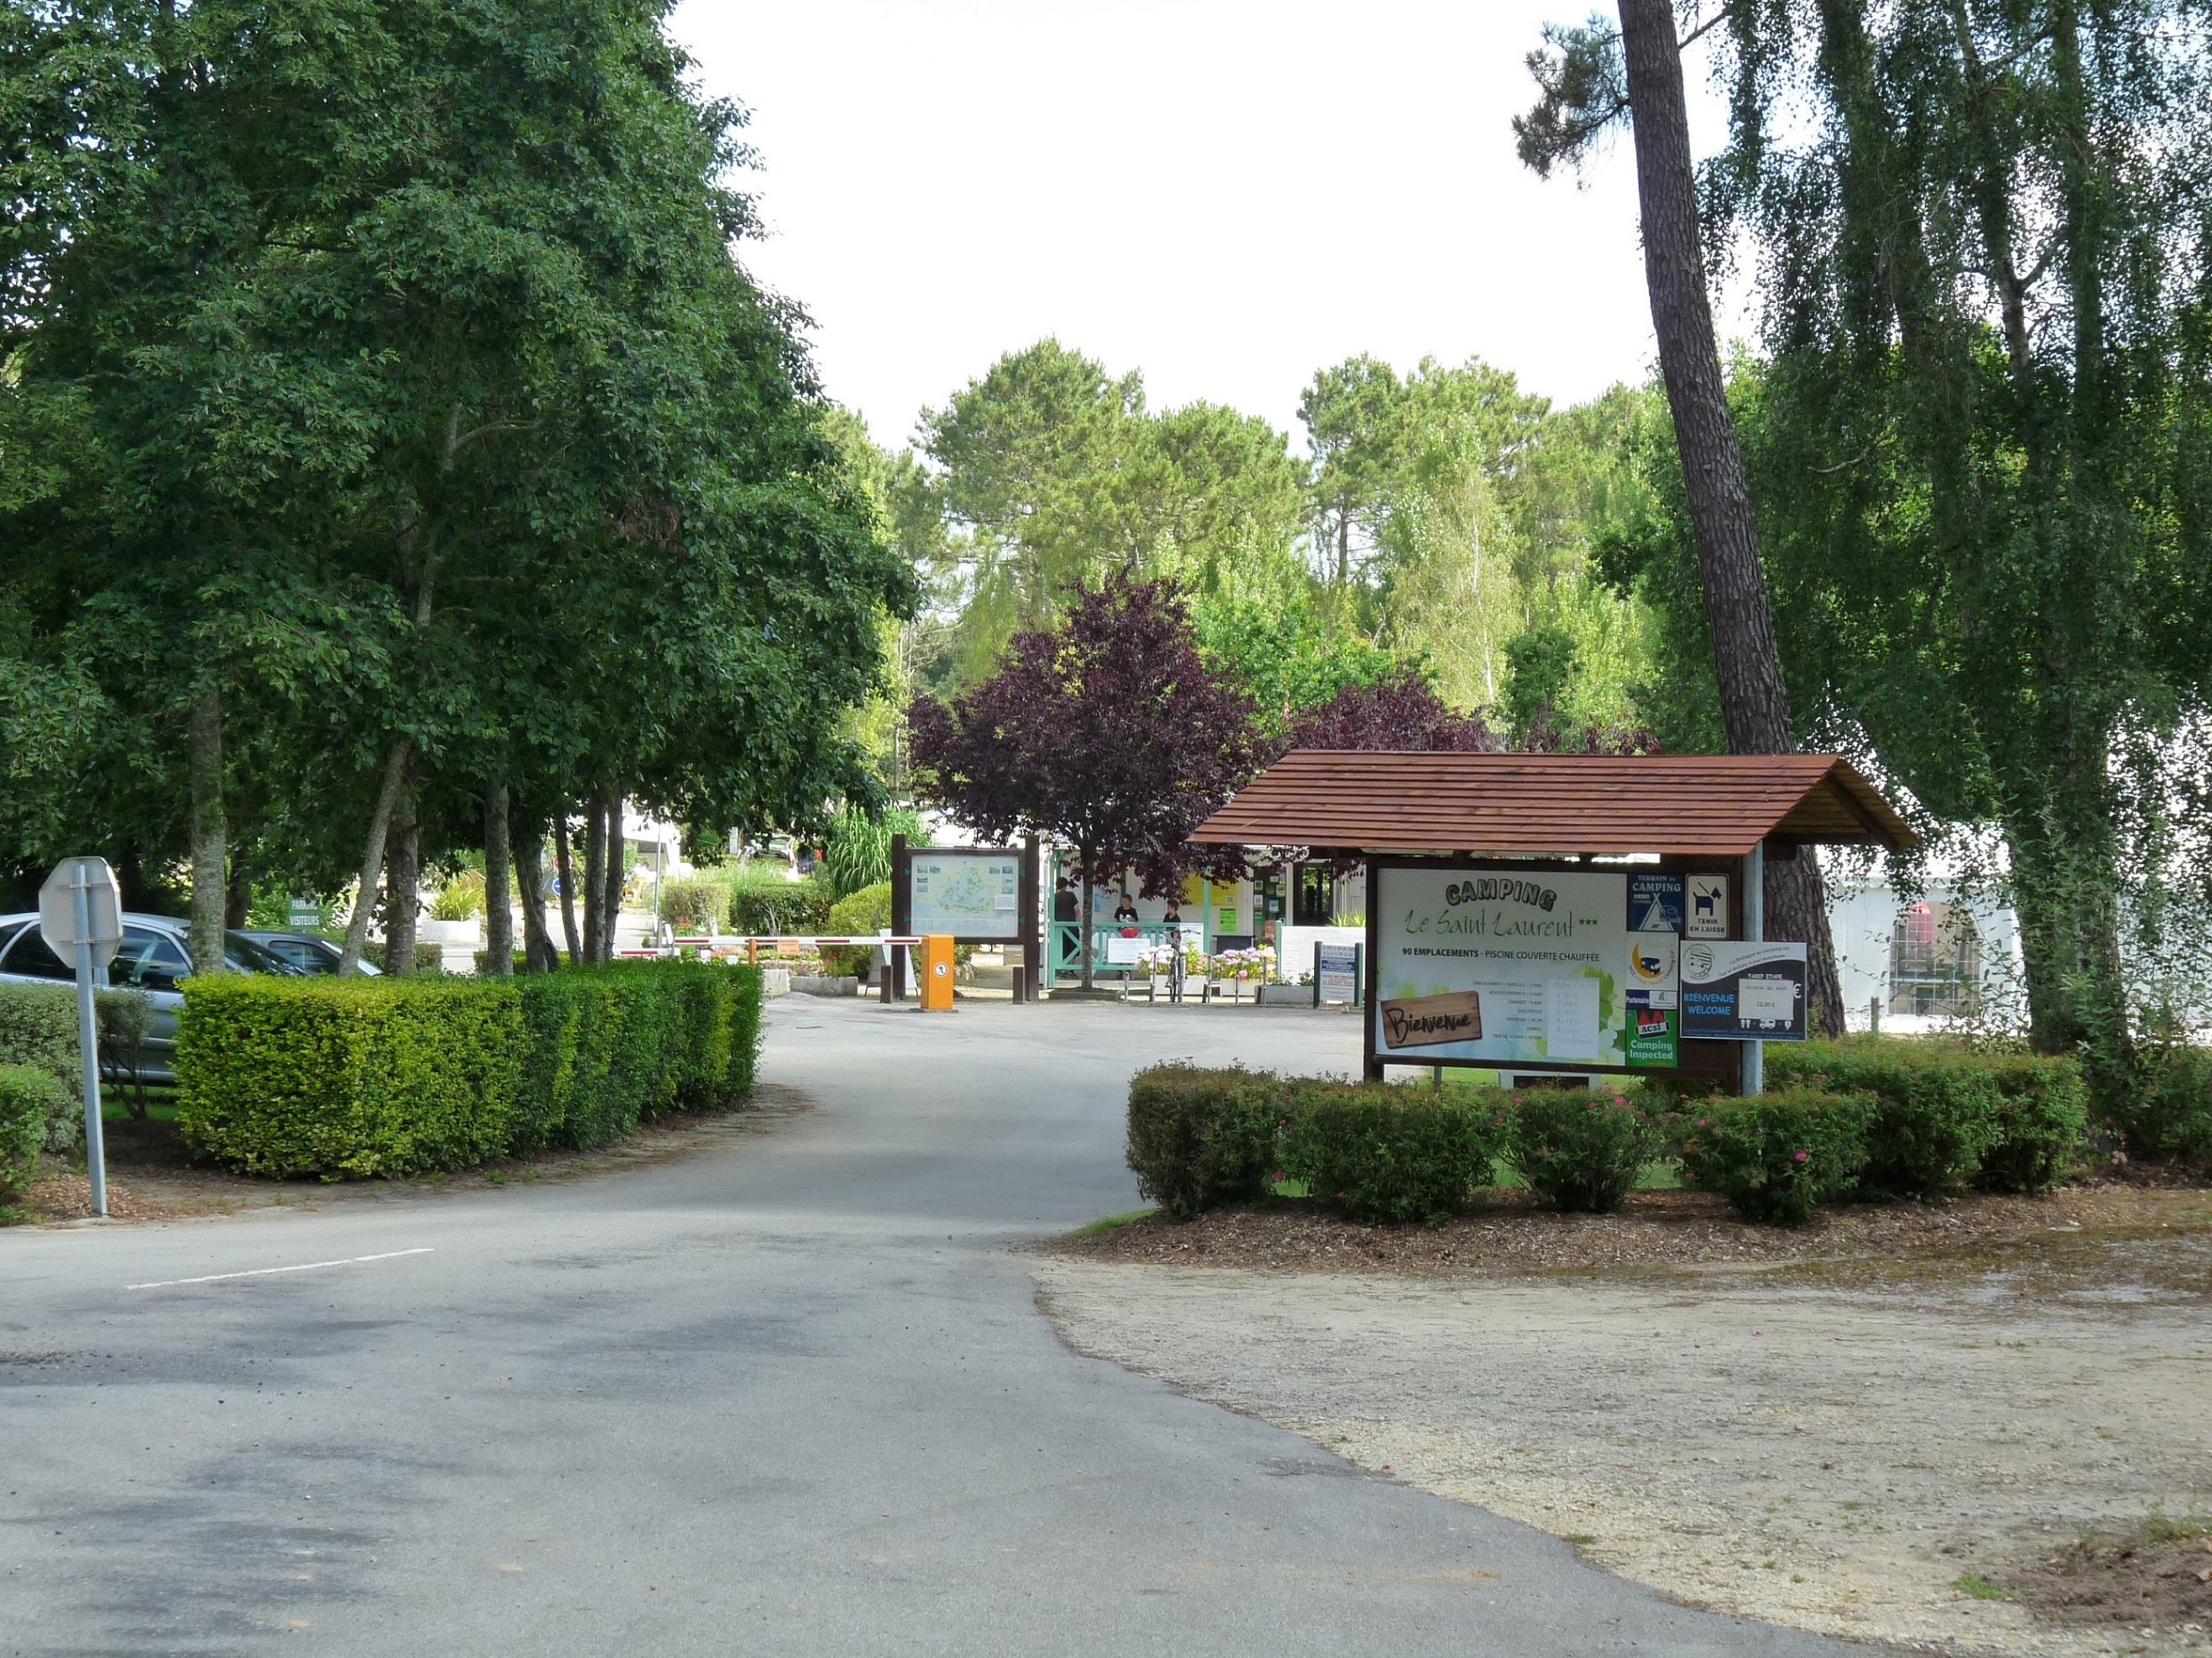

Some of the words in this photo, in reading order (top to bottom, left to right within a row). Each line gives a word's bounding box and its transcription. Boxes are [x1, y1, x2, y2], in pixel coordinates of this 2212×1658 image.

[1632, 883, 1681, 892] CAMPING
[1445, 879, 1557, 912] CAMPING
[290, 915, 319, 925] VISITEURS
[1405, 910, 1429, 934] Le
[1436, 909, 1484, 935] Saint
[1493, 911, 1575, 937] Laurent
[1413, 948, 1479, 957] EMPLACEMENTS
[1484, 950, 1515, 959] PISCINE
[1516, 951, 1557, 961] COUVERTE
[1793, 983, 1802, 998] €
[1684, 993, 1735, 1003] BIENVENUE
[1687, 1006, 1730, 1015] WELCOME
[1385, 1008, 1472, 1044] Bienvenue
[1641, 1025, 1662, 1033] ACSI
[1630, 1040, 1672, 1051] Camping
[1630, 1049, 1673, 1060] Inspected
